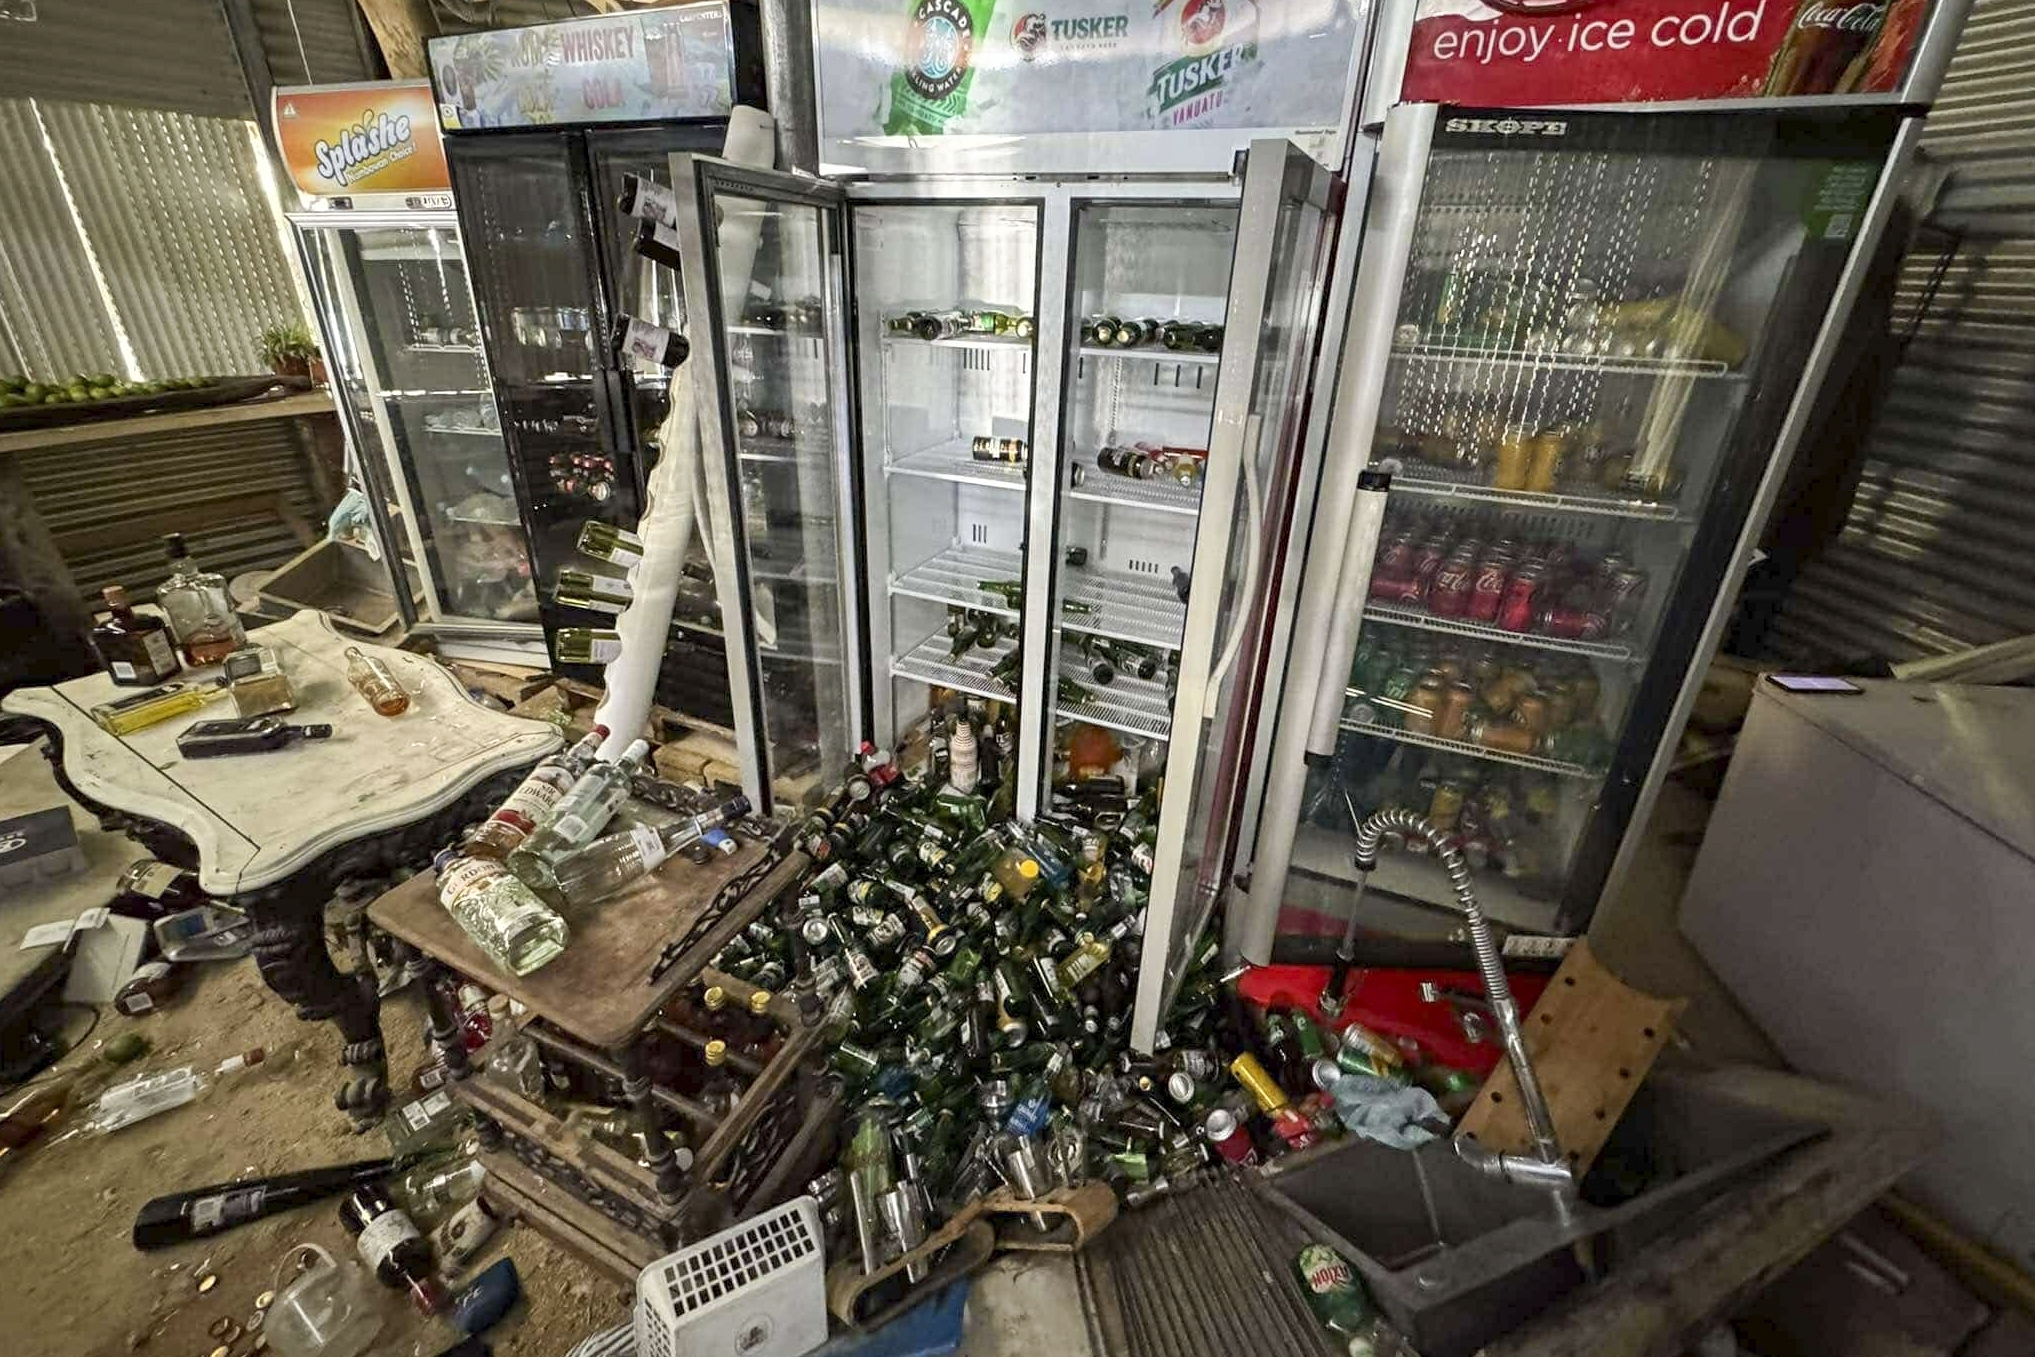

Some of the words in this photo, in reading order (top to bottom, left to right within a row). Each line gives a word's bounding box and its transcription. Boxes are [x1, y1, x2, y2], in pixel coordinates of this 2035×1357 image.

[1051, 15, 1129, 41] TUSKER
[1433, 18, 1556, 65] enjoy
[1567, 13, 1636, 52] ice
[1651, 0, 1767, 48] cold
[1798, 2, 1885, 32] Coca-Cola
[562, 26, 635, 64] WHISKEY
[1156, 43, 1246, 106] TUSKER
[1172, 90, 1224, 126] VANUATU
[1445, 117, 1568, 137] SKOPE
[315, 111, 412, 187] Splashe
